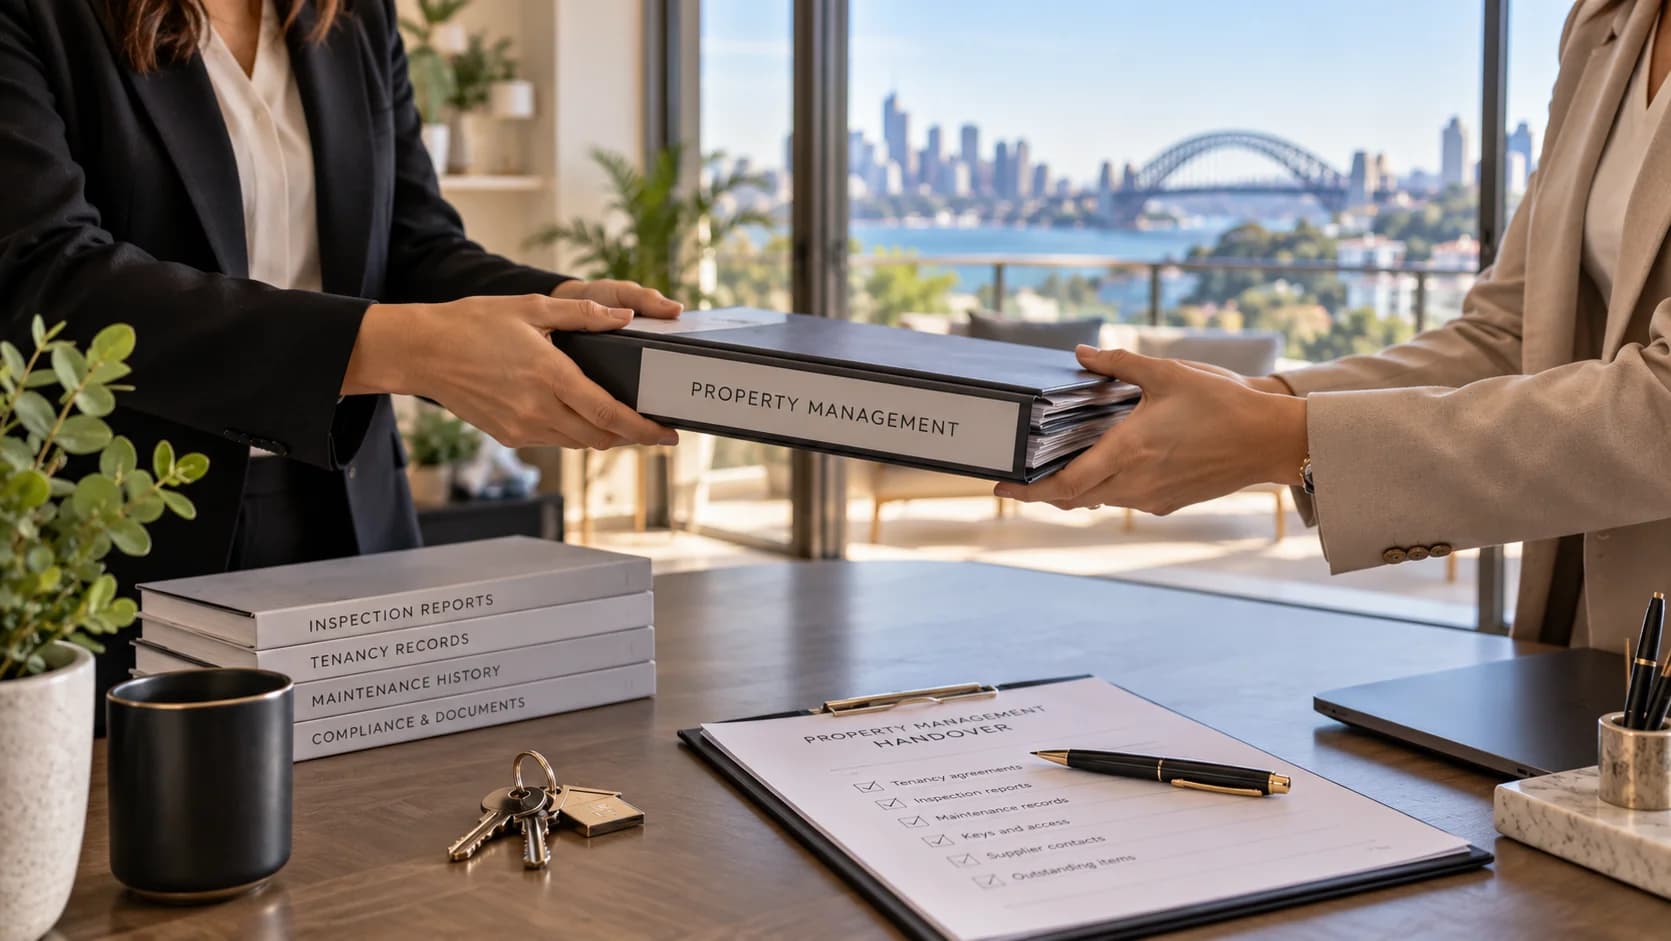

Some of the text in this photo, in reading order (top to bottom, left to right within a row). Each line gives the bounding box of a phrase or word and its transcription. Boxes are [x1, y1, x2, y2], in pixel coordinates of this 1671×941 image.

[691, 381, 960, 437] PROPERTY MANAGEMENT
[309, 594, 494, 632] INSPECTION REPORTS
[311, 633, 469, 669] TENANCY RECORDS
[312, 665, 500, 707] MAINTENANCE HISTORY
[312, 697, 526, 745] COMPLIANCE & DOCUMENTS
[804, 705, 1048, 744] PROPERTY MANAGEMENT
[873, 723, 1013, 748] HANDOVER
[890, 764, 1024, 787] Tenancy agreements
[914, 782, 1032, 805] Inspection reports
[936, 797, 1069, 821] Maintenance records
[961, 818, 1070, 841] Keys and access
[986, 835, 1106, 861] Supplier contacts
[1011, 853, 1136, 881] Outstanding items
